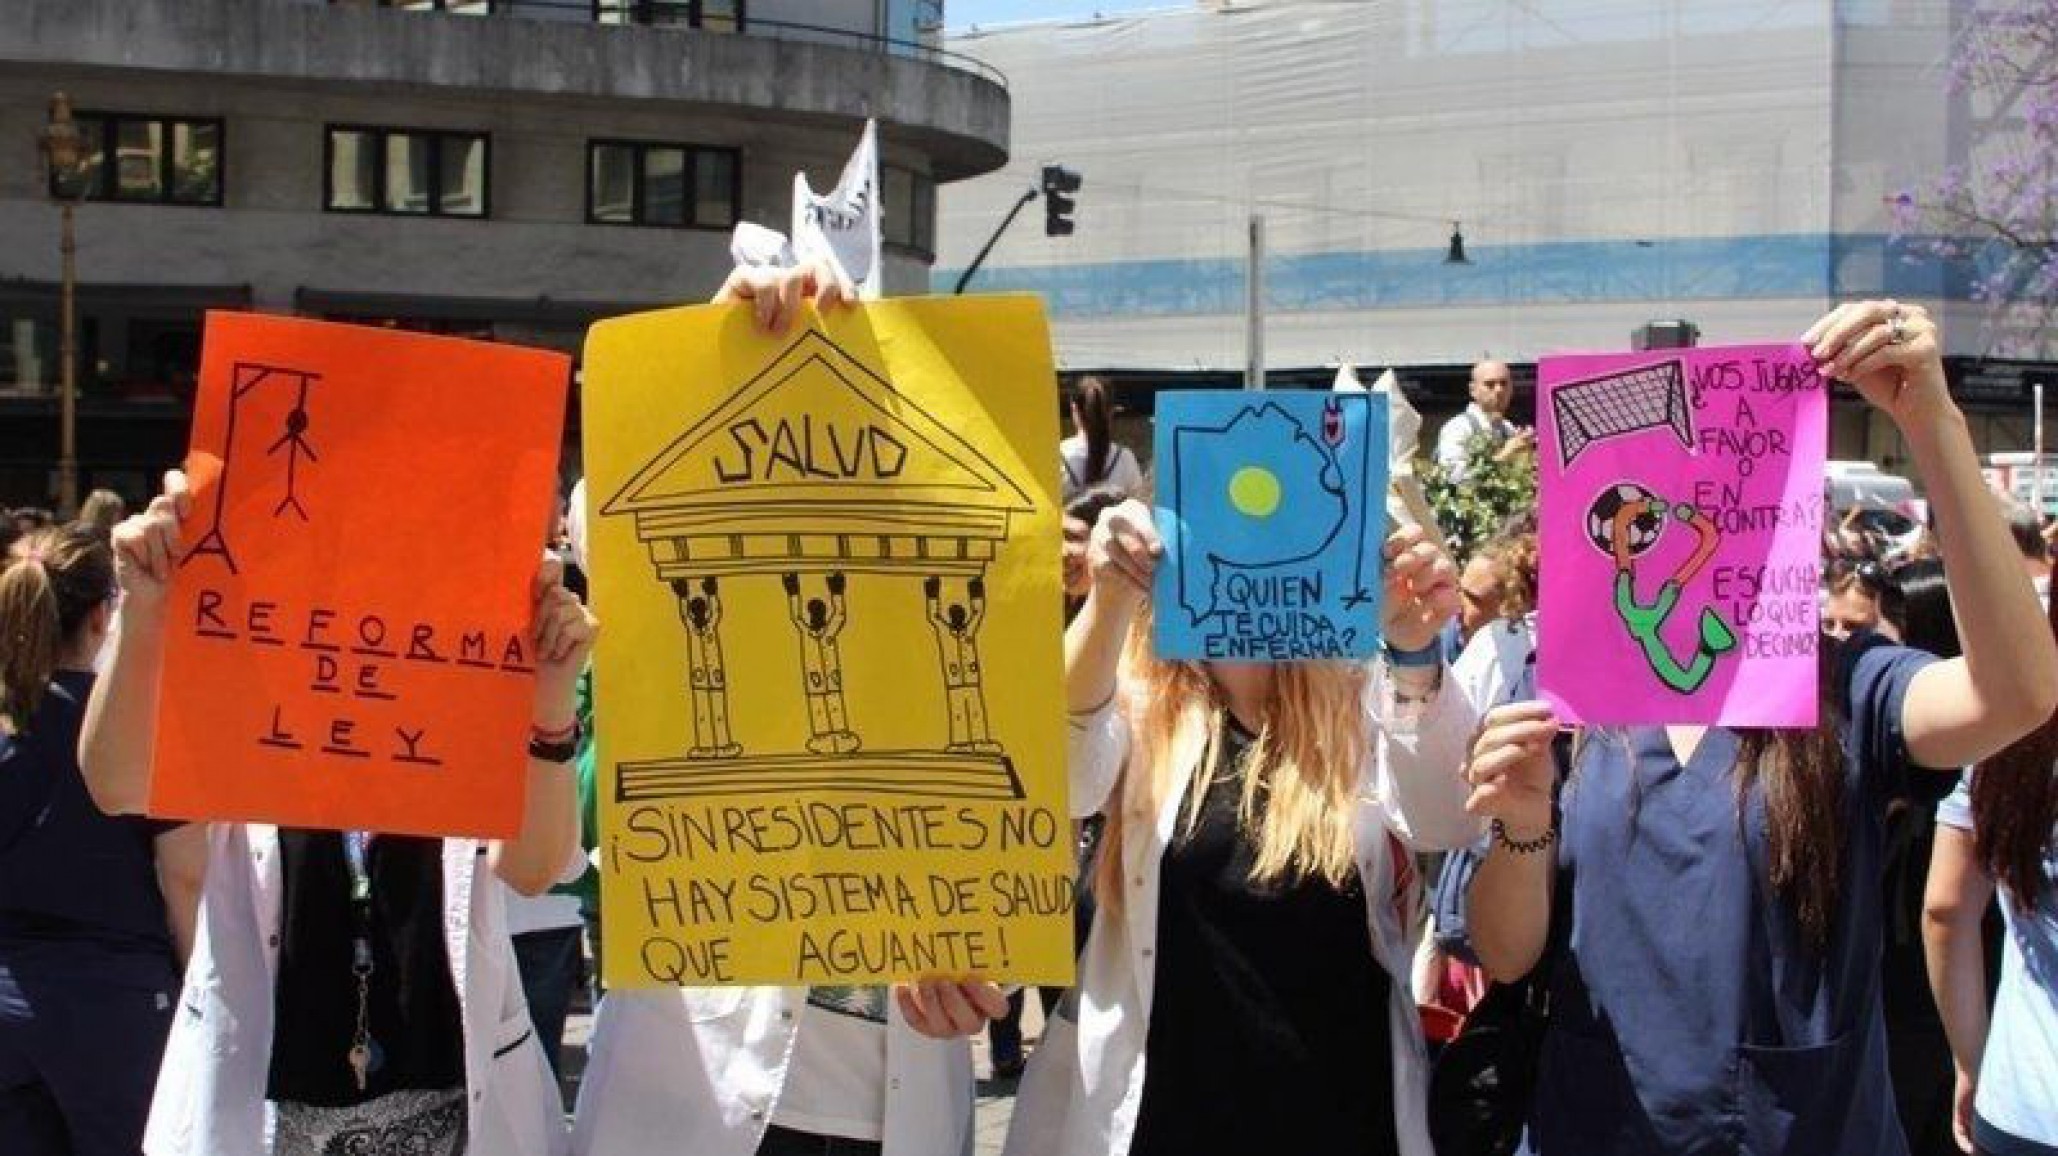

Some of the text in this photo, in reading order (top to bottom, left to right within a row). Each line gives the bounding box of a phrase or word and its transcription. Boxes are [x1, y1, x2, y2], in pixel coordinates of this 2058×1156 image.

[1735, 396, 1756, 427] A
[714, 413, 907, 482] SALUD
[1700, 428, 1790, 458] FAVOR
[1694, 478, 1744, 510] EN
[1227, 570, 1323, 610] QUIEN
[197, 589, 530, 668] REFORMA
[314, 656, 388, 694] DE
[265, 706, 431, 761] LEY
[1001, 808, 1056, 850] NO
[643, 870, 1076, 927] HAY SISTEMA DE SALUD
[641, 937, 734, 986] QUE
